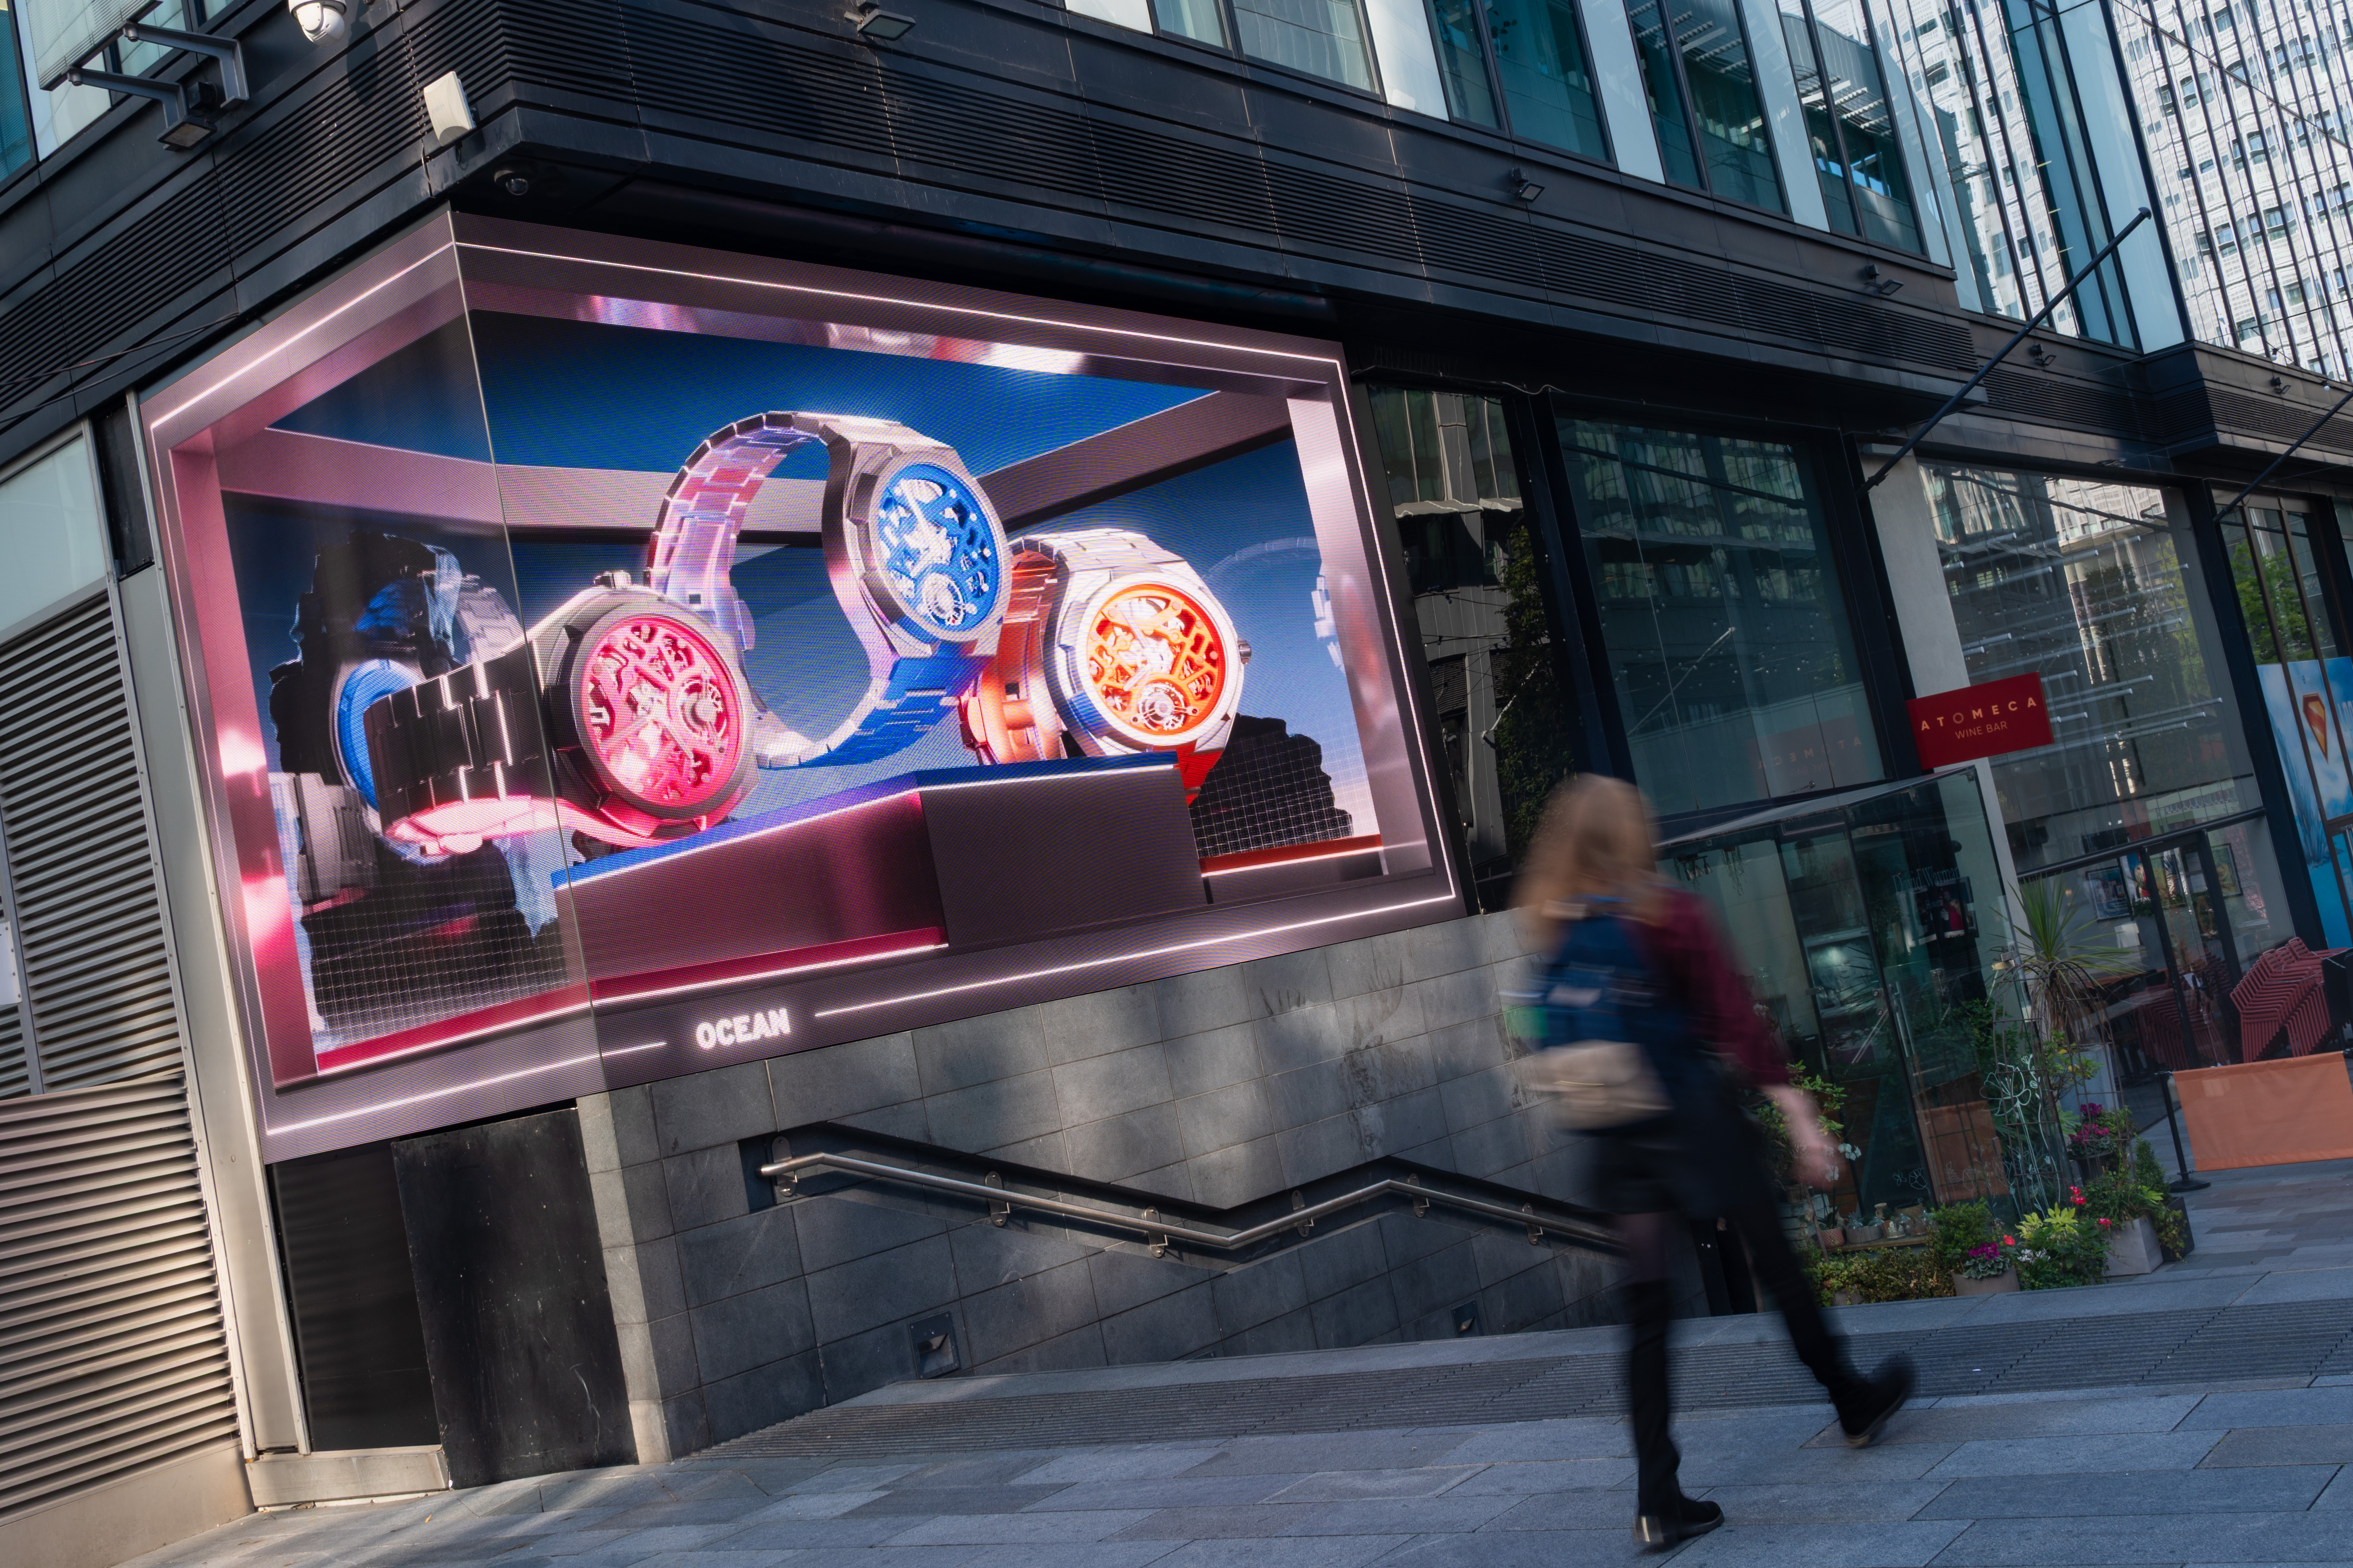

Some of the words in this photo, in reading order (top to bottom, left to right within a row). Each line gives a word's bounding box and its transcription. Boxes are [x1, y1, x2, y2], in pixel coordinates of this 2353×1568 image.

[1921, 697, 2036, 730] ATOMECA
[1955, 726, 1983, 739] WINE
[1987, 721, 2007, 733] BAR
[1892, 868, 1923, 892] David
[1922, 866, 1960, 891] Wayman
[696, 1008, 791, 1049] OCEAN
